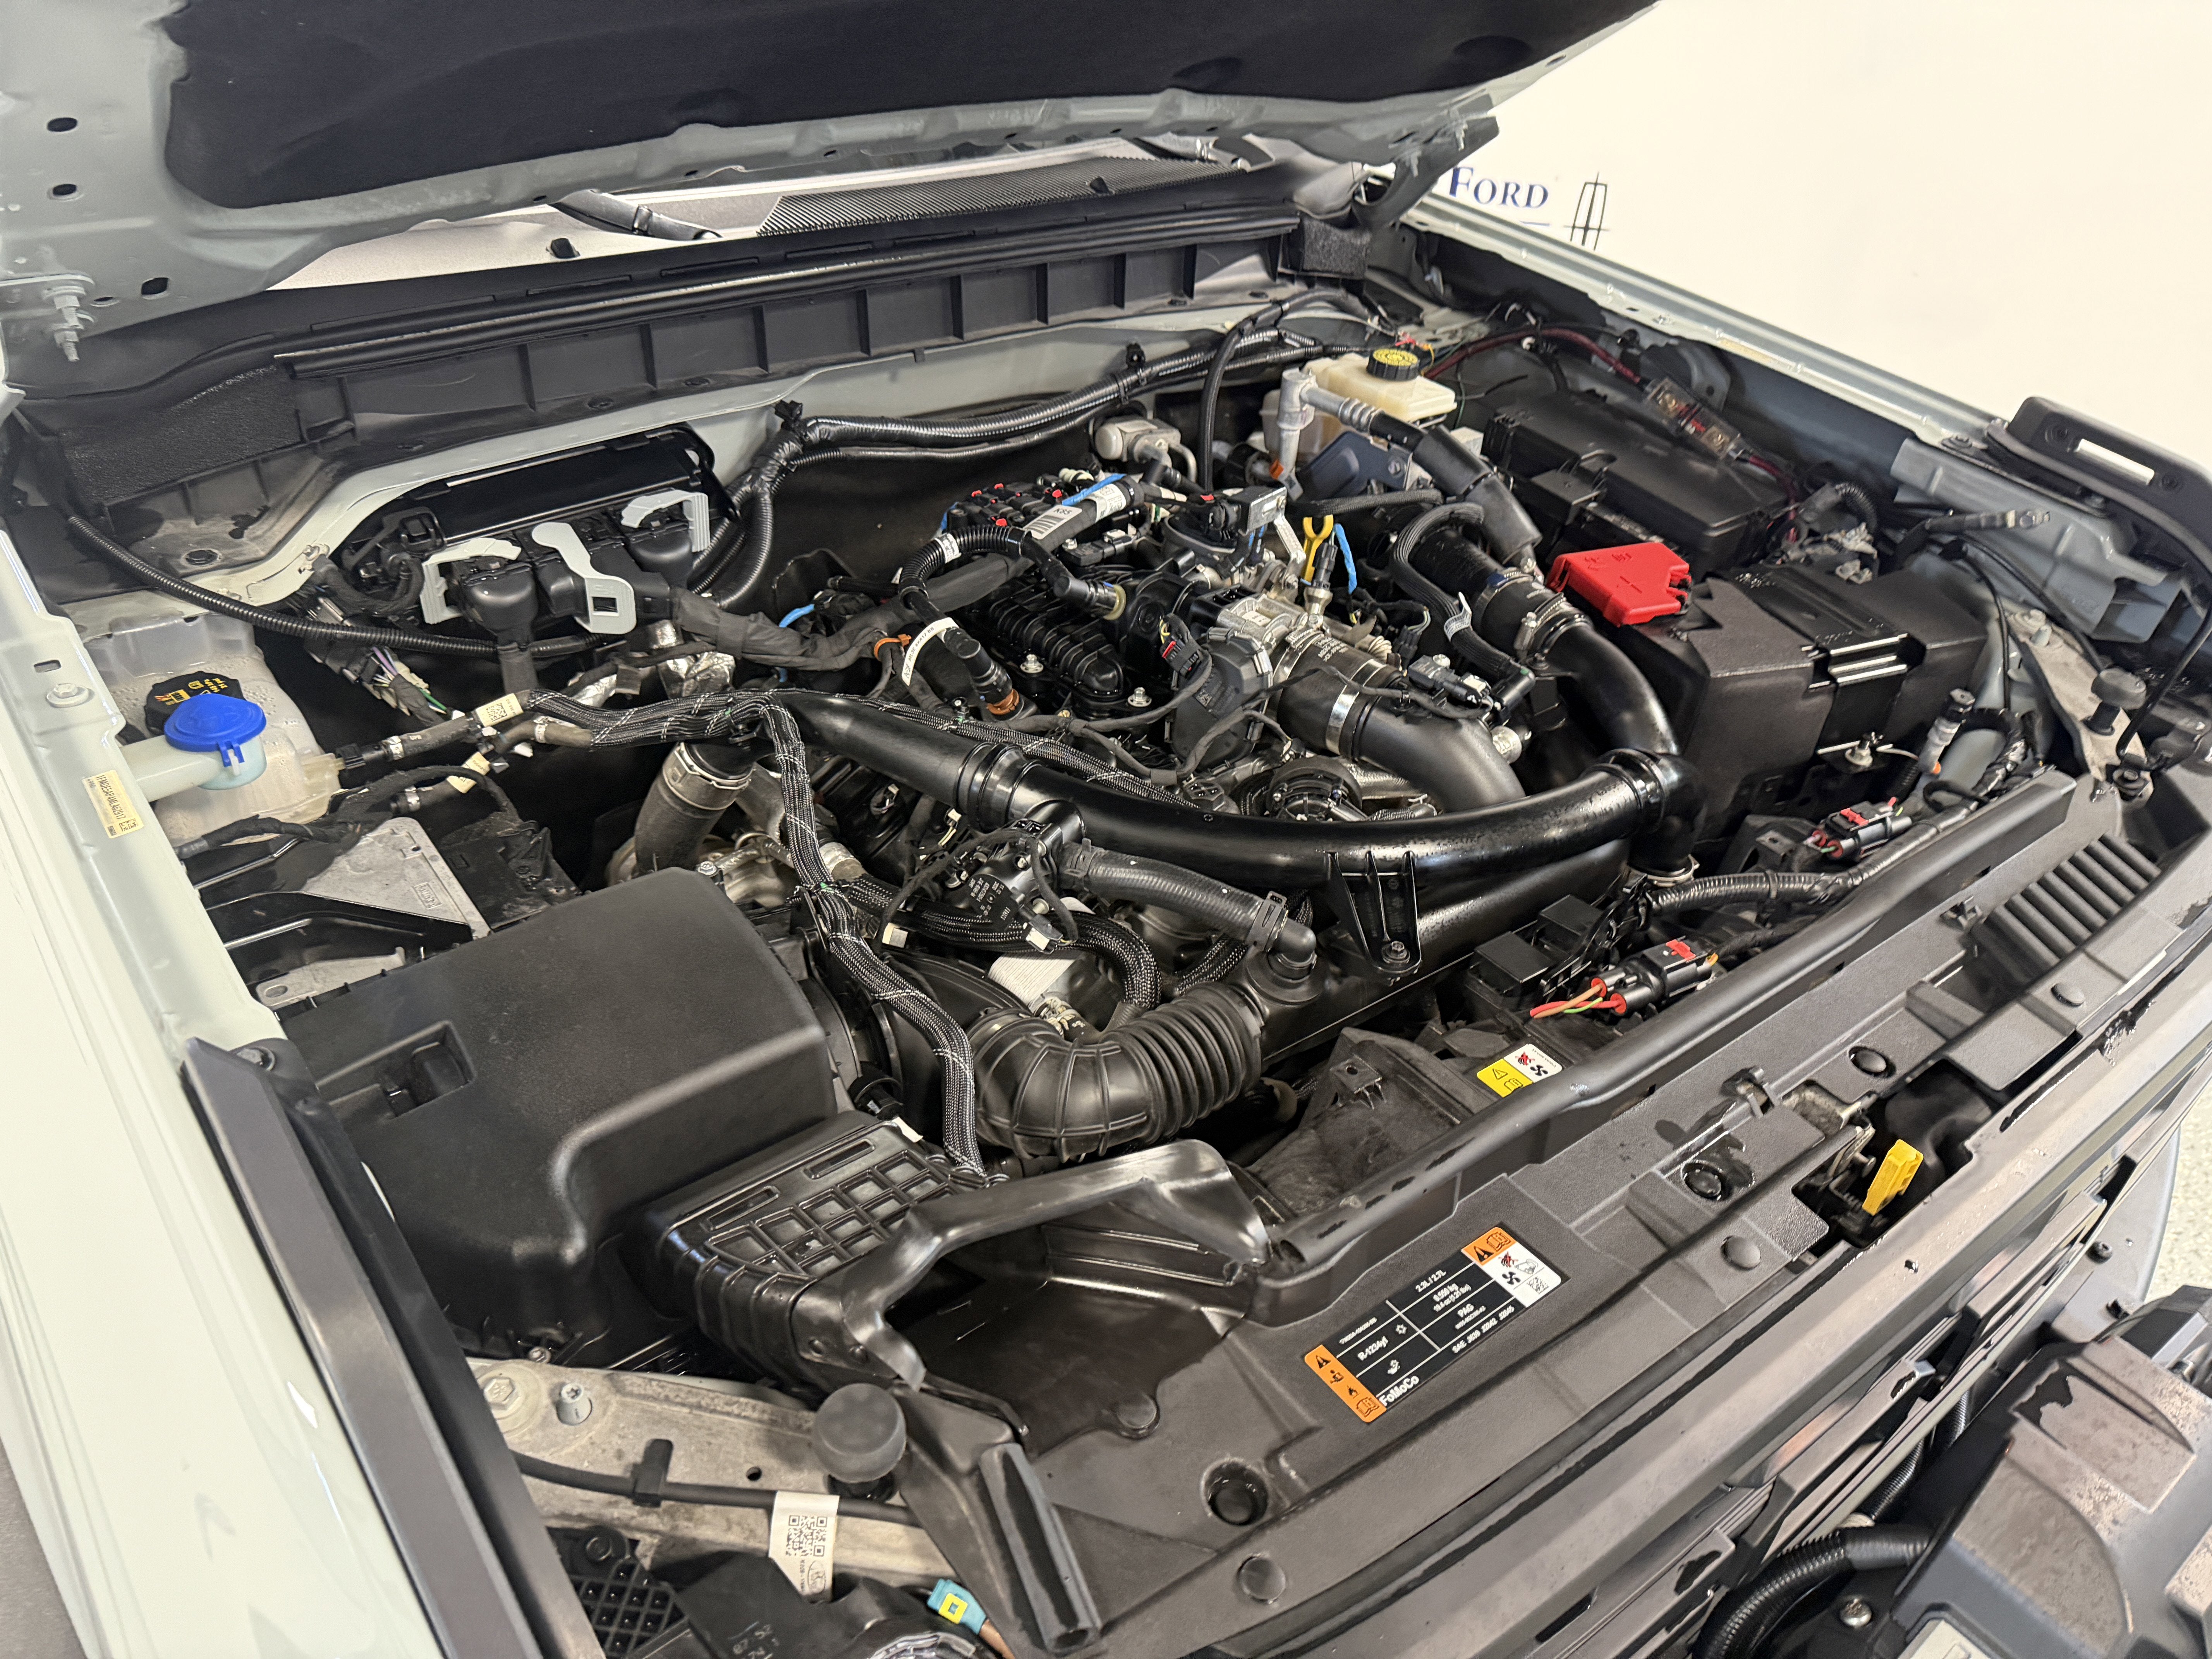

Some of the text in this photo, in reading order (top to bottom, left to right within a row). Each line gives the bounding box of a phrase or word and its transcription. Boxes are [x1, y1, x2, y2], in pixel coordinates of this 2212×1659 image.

[1457, 1303, 1474, 1317] PAG
[1452, 1340, 1467, 1353] SAE
[1379, 1376, 1419, 1406] FoMoCo
